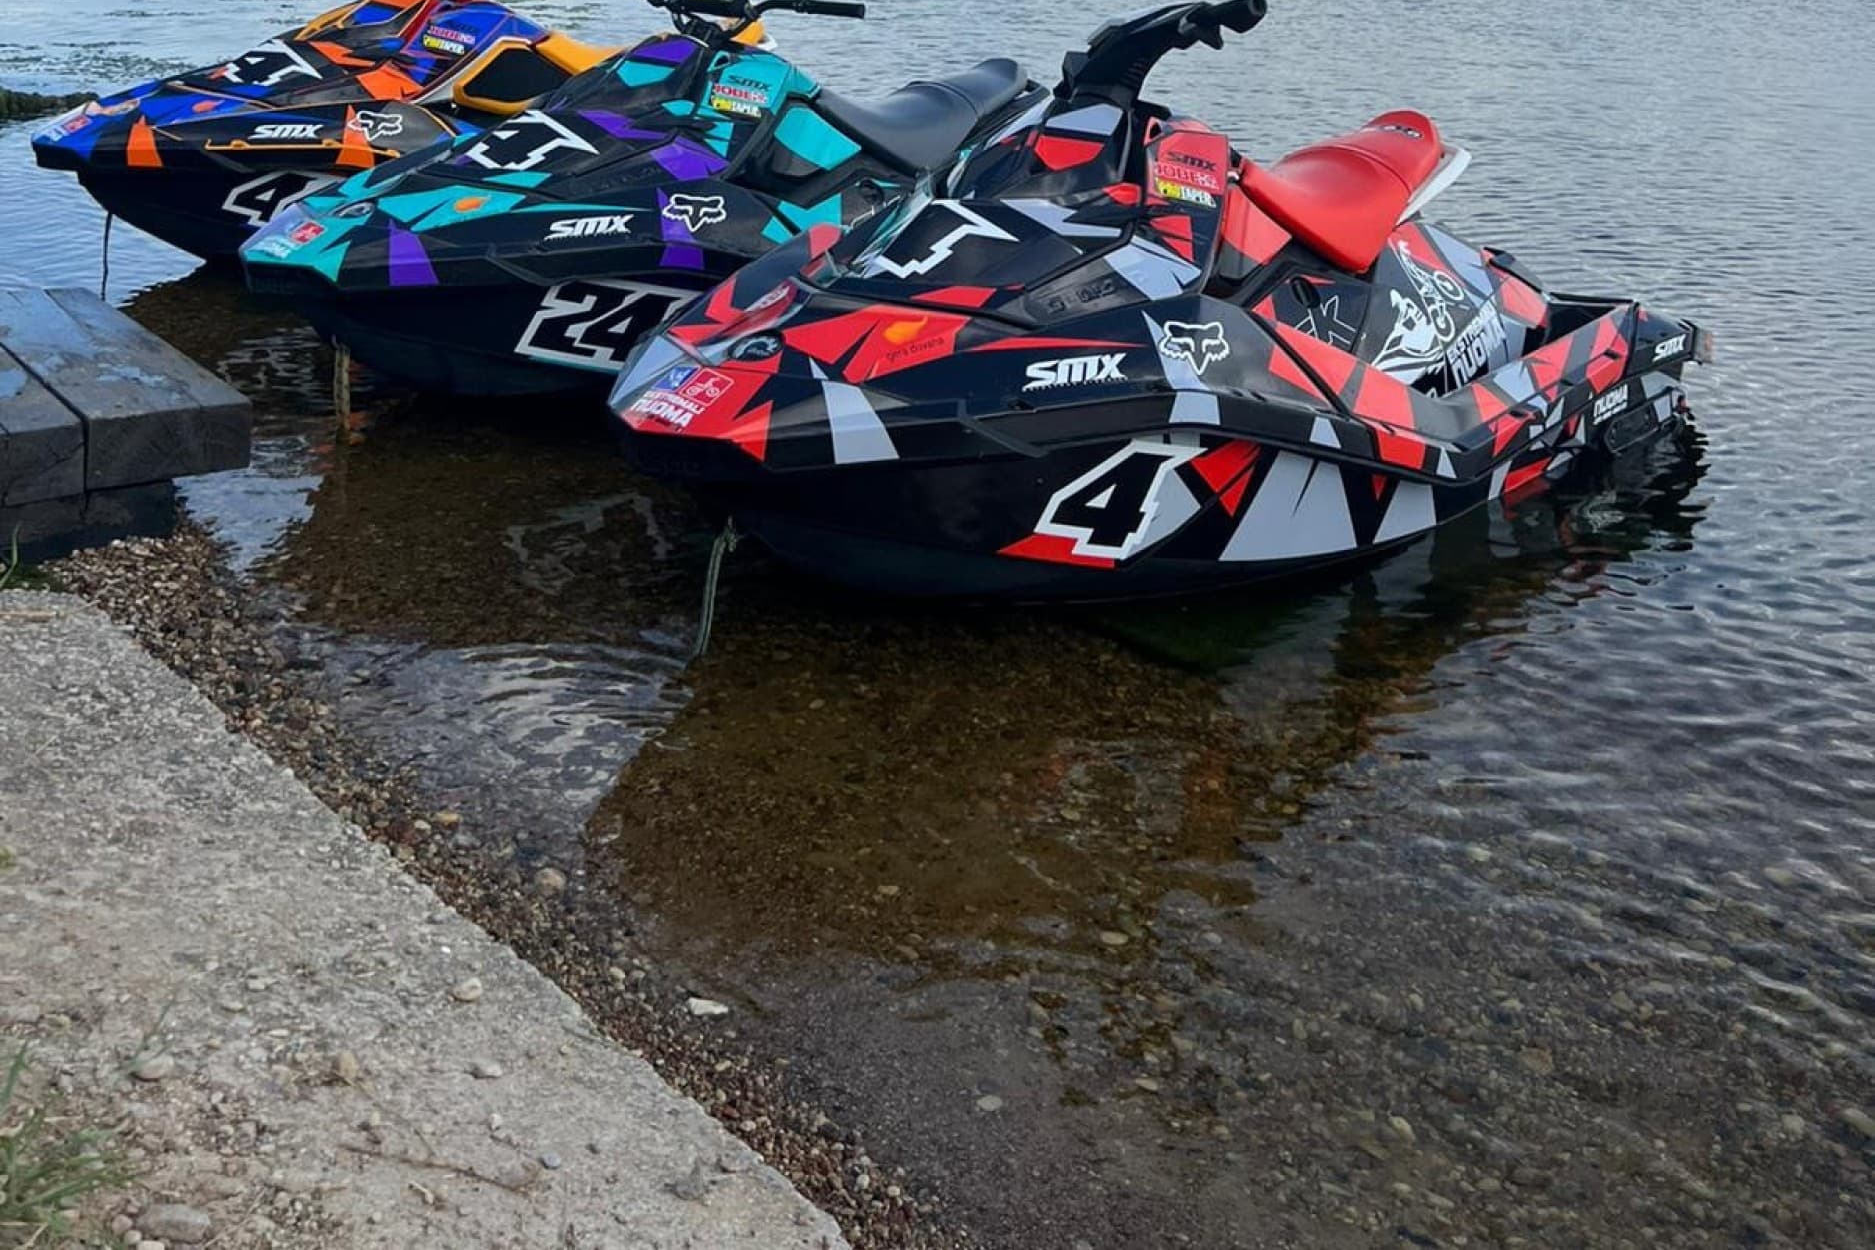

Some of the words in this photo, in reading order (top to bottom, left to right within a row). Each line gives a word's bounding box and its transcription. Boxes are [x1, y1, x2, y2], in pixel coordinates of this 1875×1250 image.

[248, 124, 324, 139] SMX
[222, 170, 348, 227] 4
[544, 214, 634, 240] SMX
[514, 279, 704, 368] 24
[1652, 334, 1686, 363] SMX
[1022, 352, 1128, 392] SMX
[630, 400, 694, 428] NUOMA
[1033, 438, 1208, 560] 4
